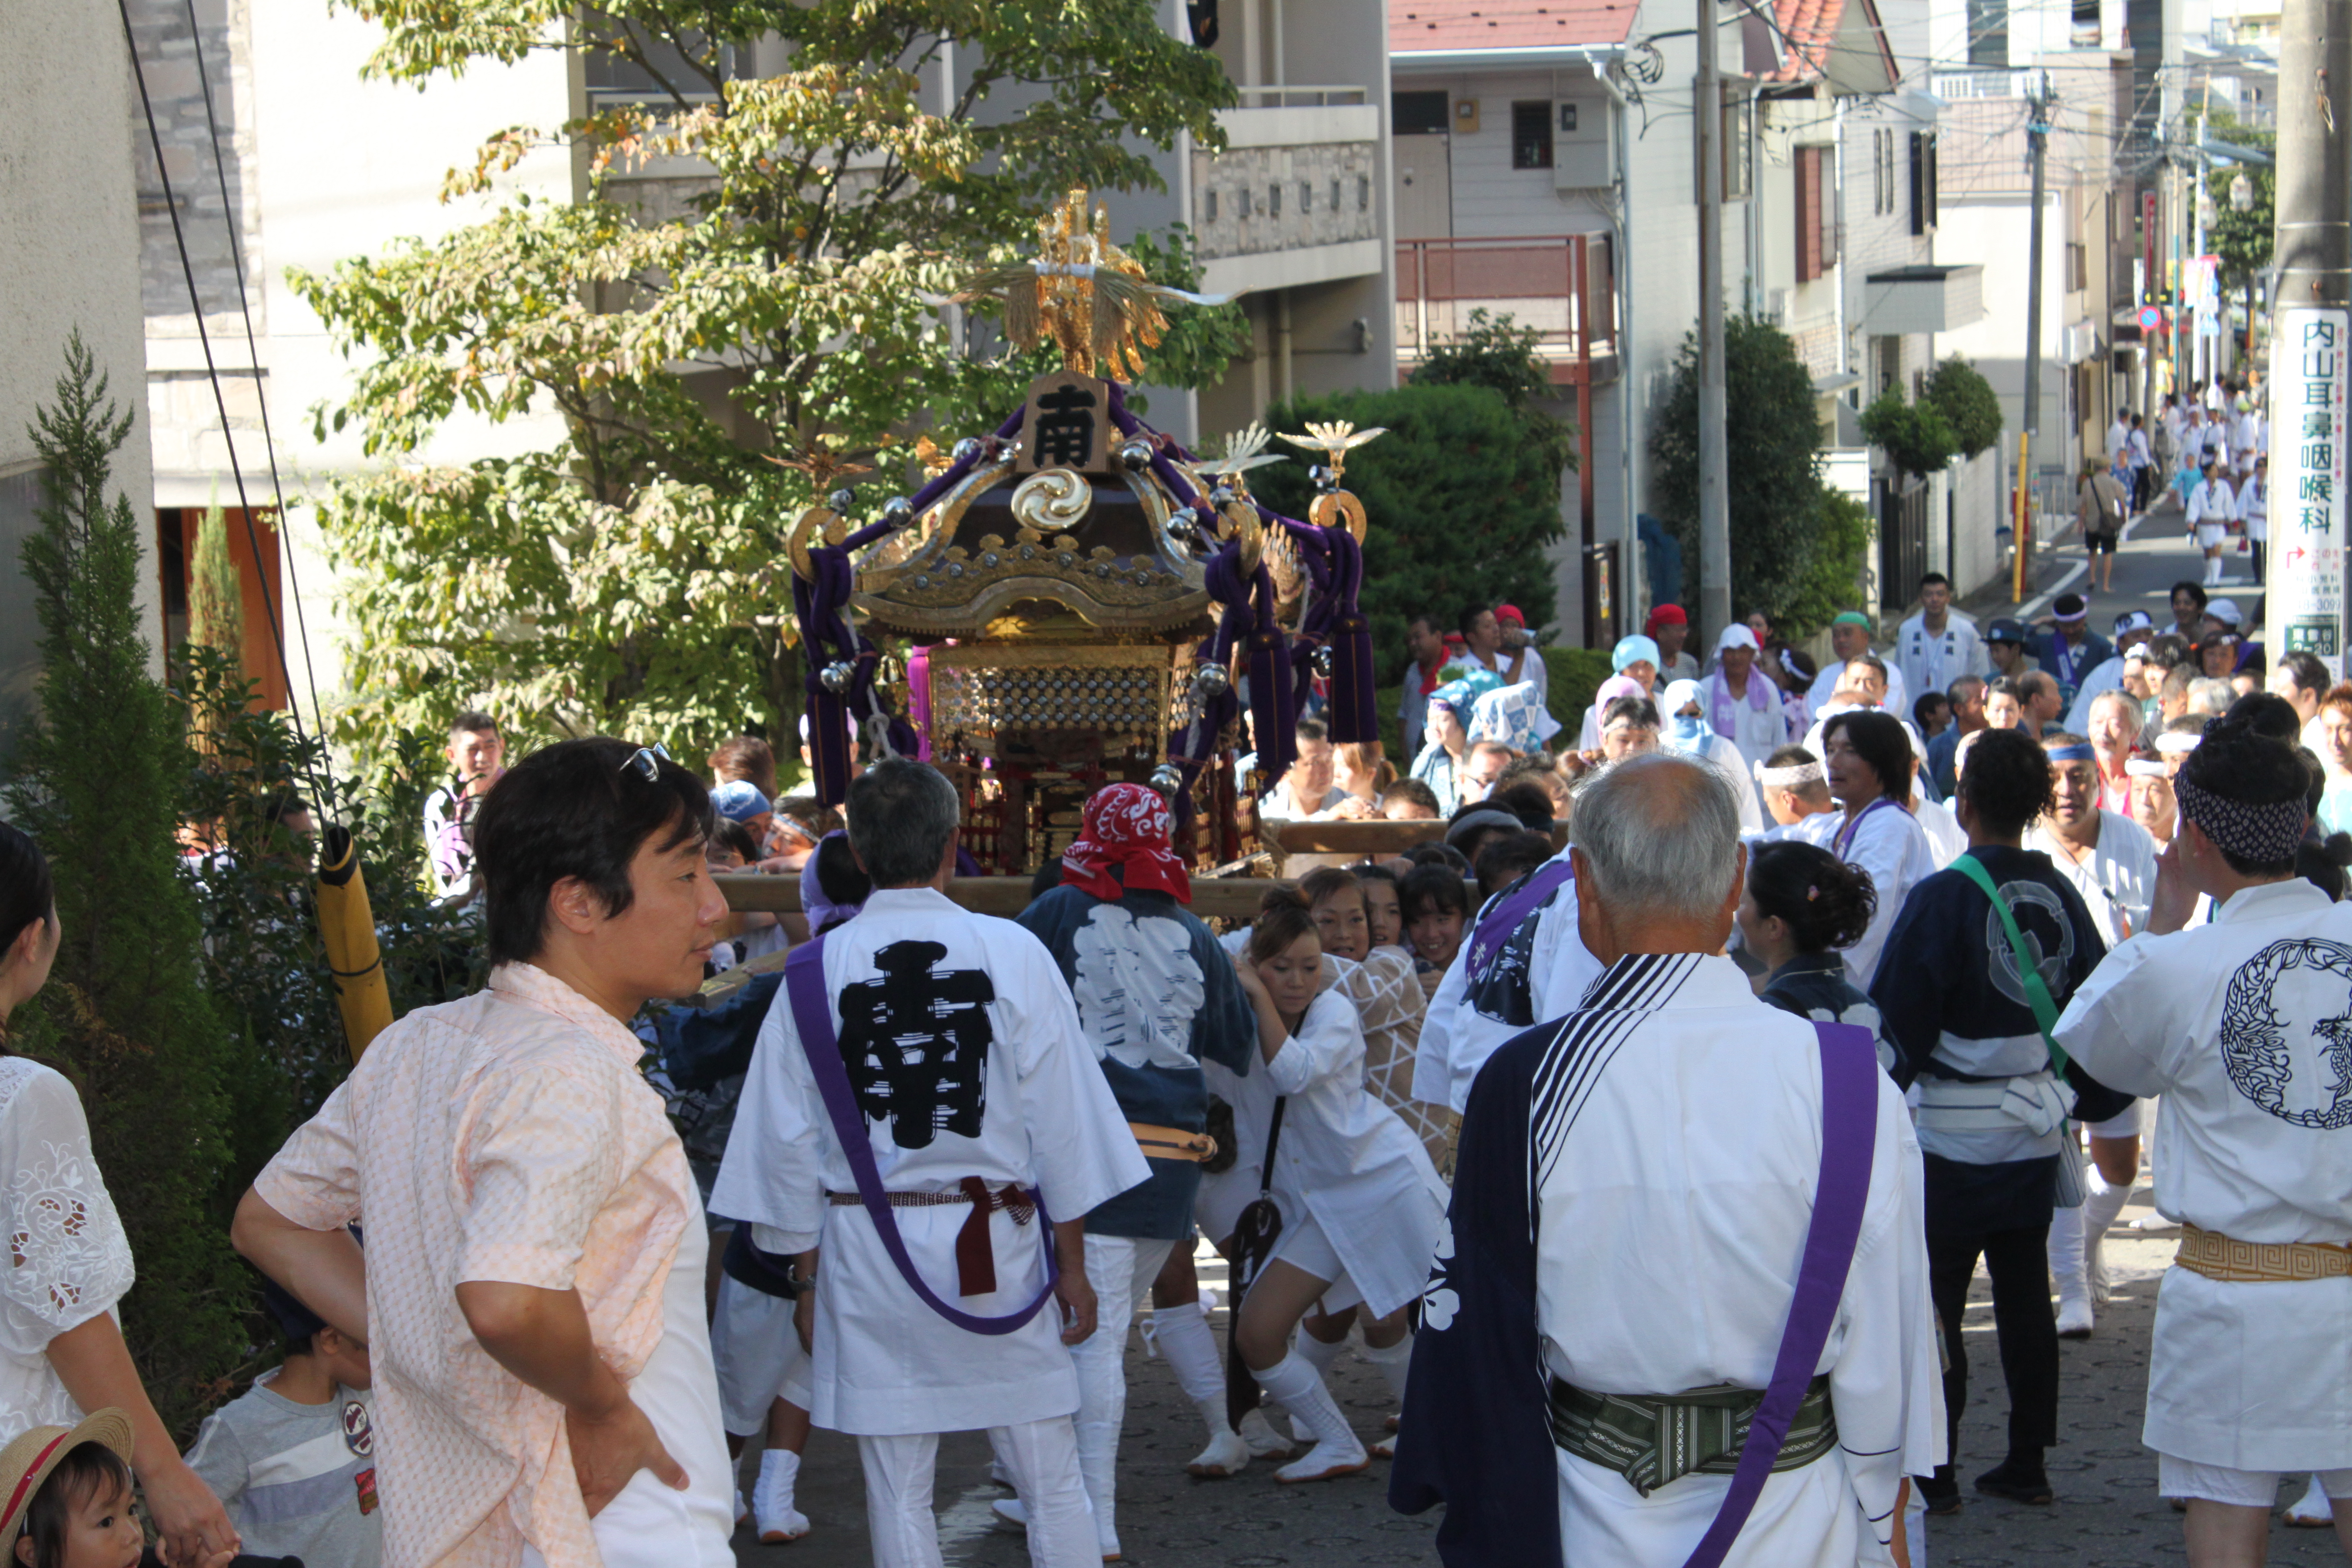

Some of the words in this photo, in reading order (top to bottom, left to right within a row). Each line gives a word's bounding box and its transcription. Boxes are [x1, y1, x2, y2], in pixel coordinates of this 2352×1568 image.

[1033, 384, 1097, 468] 南
[2299, 319, 2334, 535] 内山耳鼻咽喉科
